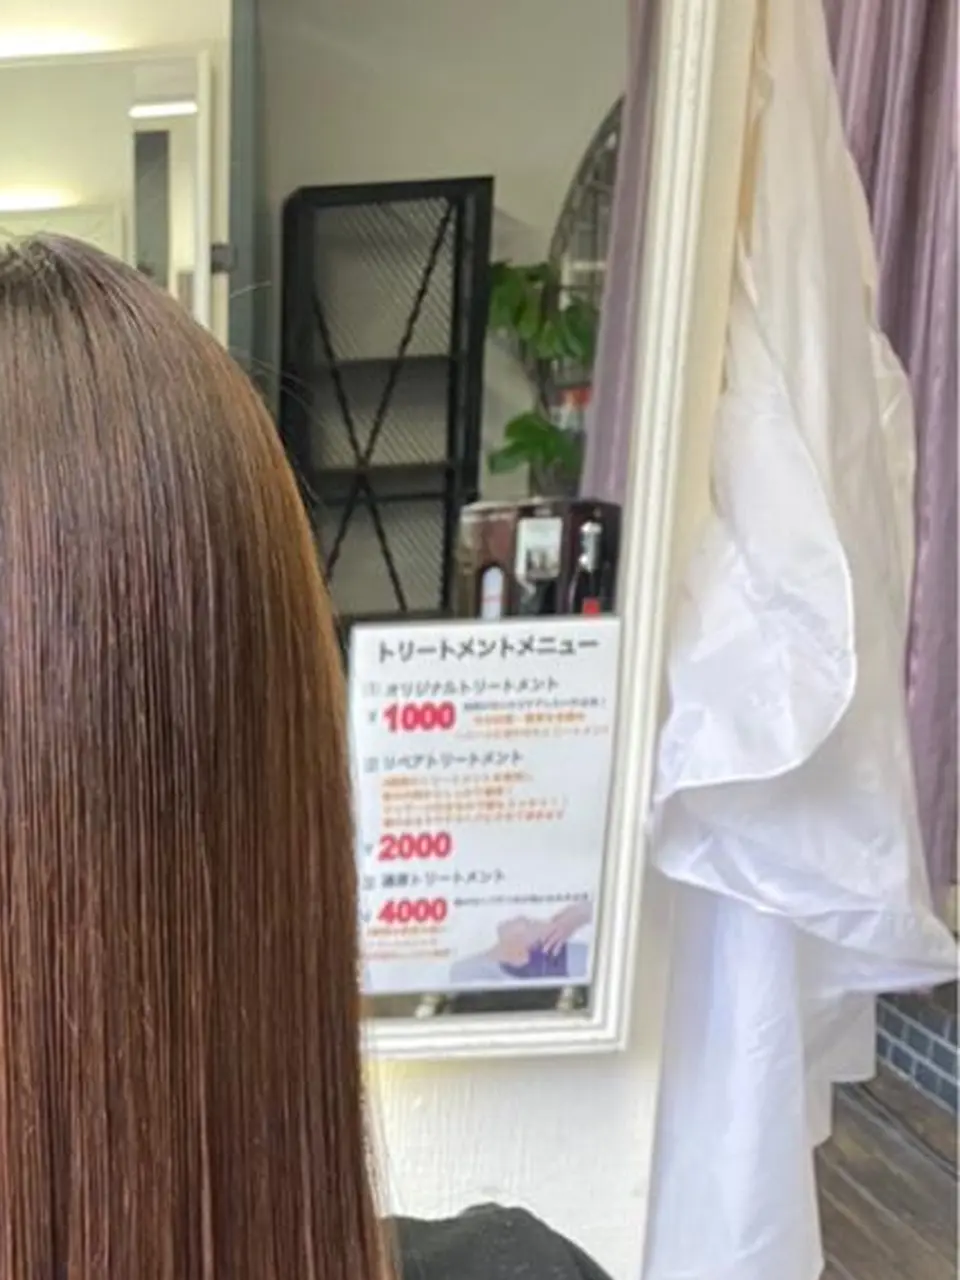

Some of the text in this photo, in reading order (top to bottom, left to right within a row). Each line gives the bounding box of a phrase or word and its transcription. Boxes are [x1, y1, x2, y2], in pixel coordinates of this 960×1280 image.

[379, 635, 600, 663] トリートメントメニュー
[385, 675, 560, 698] オリジナルトリートメント
[382, 700, 457, 732] 1000
[378, 831, 453, 862] 2000
[377, 897, 449, 925] 4000
